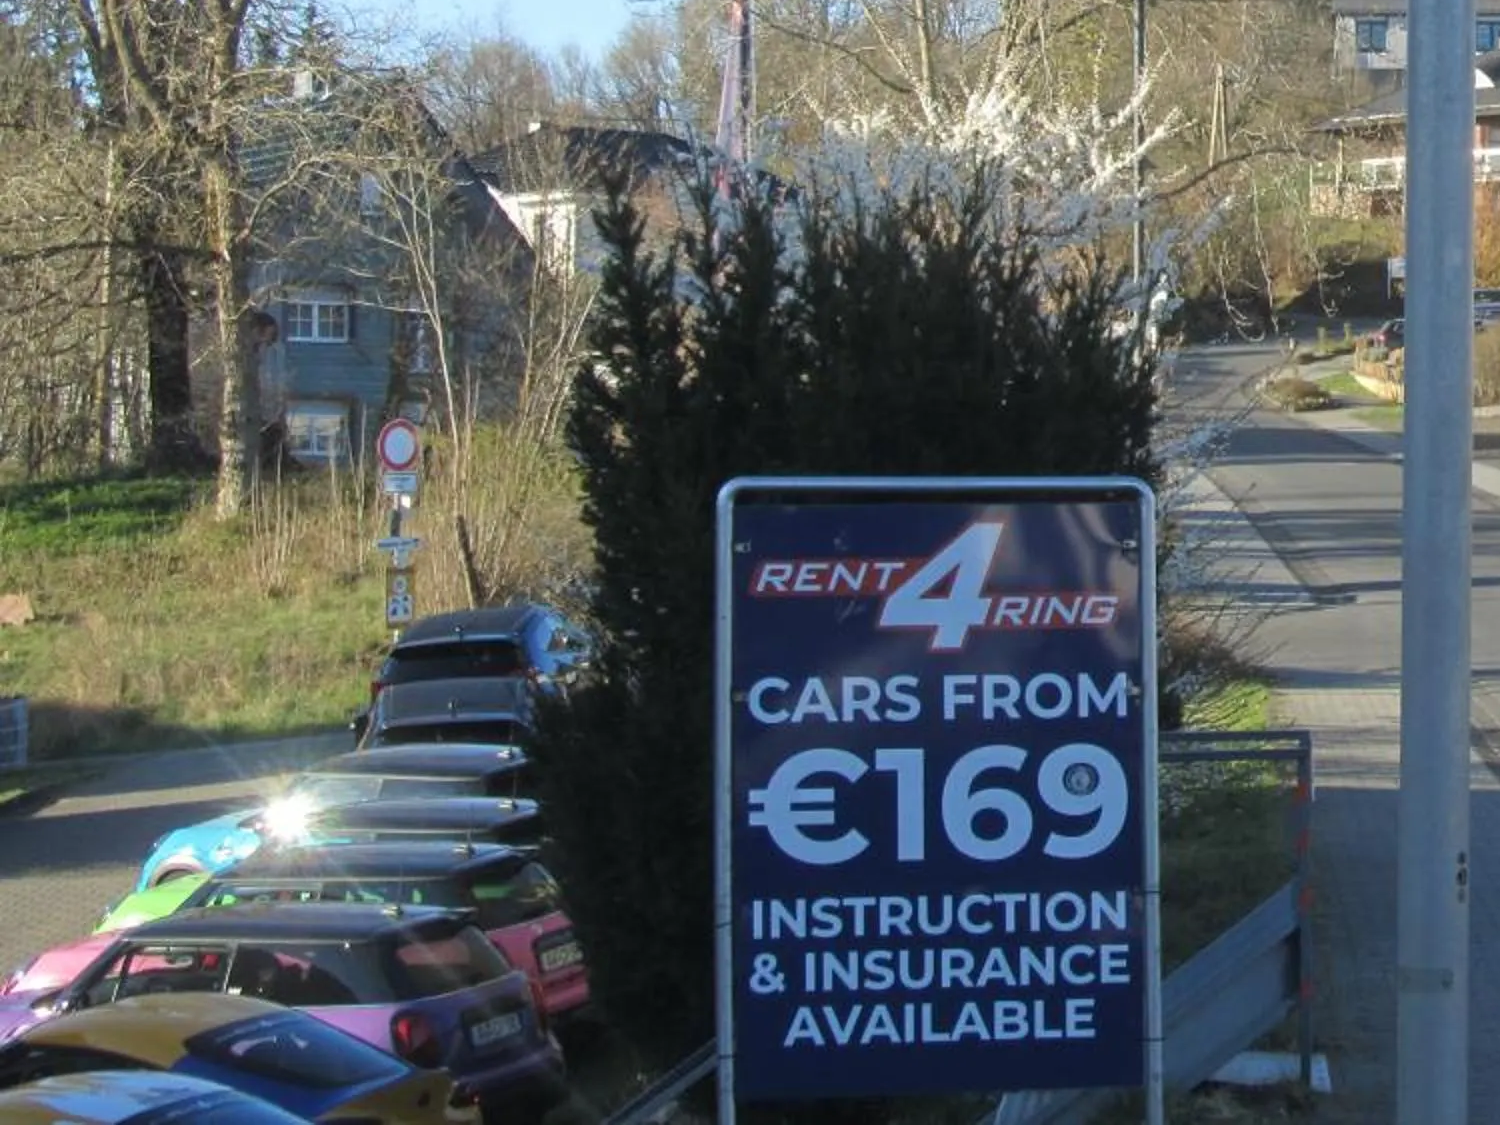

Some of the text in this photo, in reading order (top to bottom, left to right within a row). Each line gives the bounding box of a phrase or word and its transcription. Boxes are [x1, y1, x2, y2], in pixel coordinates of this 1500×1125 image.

[748, 672, 1128, 725] CARS FROM
[748, 742, 1130, 865] €169
[751, 890, 1127, 941] INSTRUCTION
[749, 944, 1131, 994] & INSURANCE
[783, 998, 1096, 1049] AVAILABLE
